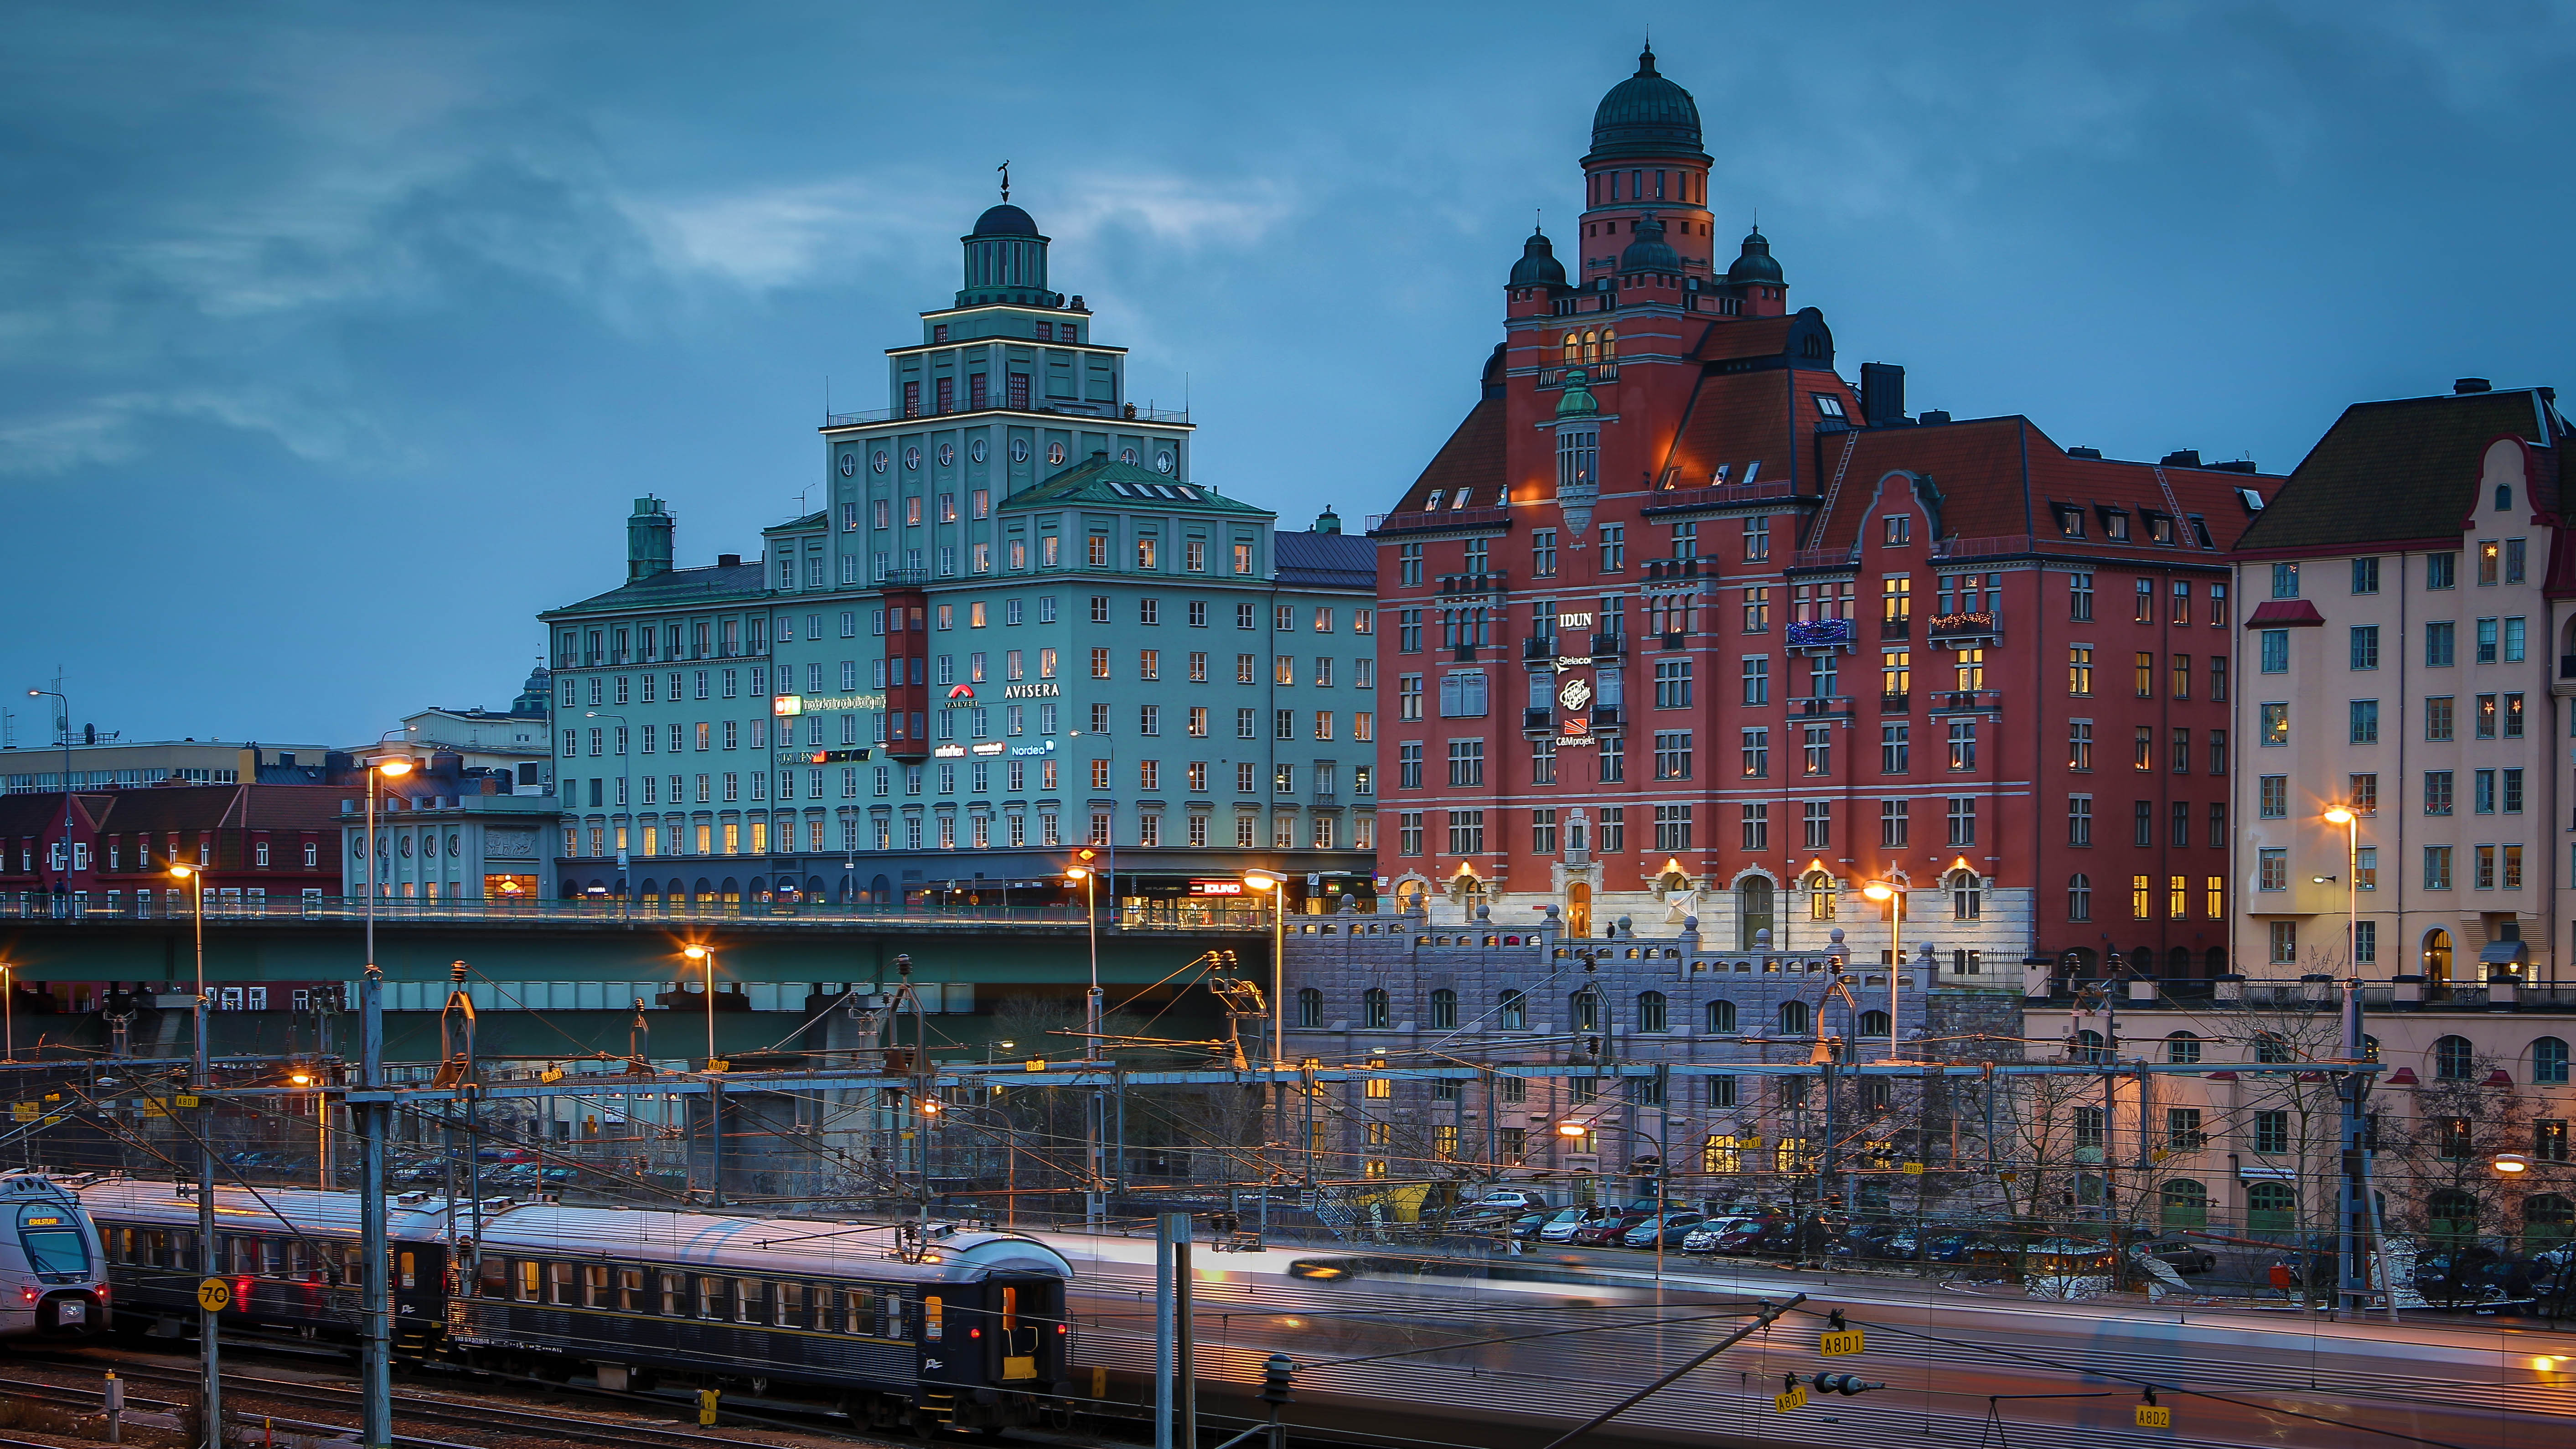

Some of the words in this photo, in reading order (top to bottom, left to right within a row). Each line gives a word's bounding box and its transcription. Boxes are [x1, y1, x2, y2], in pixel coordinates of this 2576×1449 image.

[1559, 612, 1592, 627] IDUN
[1012, 745, 1045, 756] Nordea
[709, 1061, 727, 1070] A8D2
[544, 1071, 561, 1082] A8D2
[178, 1097, 196, 1106] A8D1
[1904, 1164, 1922, 1173] B8D2
[202, 1287, 228, 1303] 70
[1824, 1335, 1859, 1354] A8D1
[1778, 1391, 1804, 1411] A8D1
[2139, 1411, 2167, 1426] A8D2
